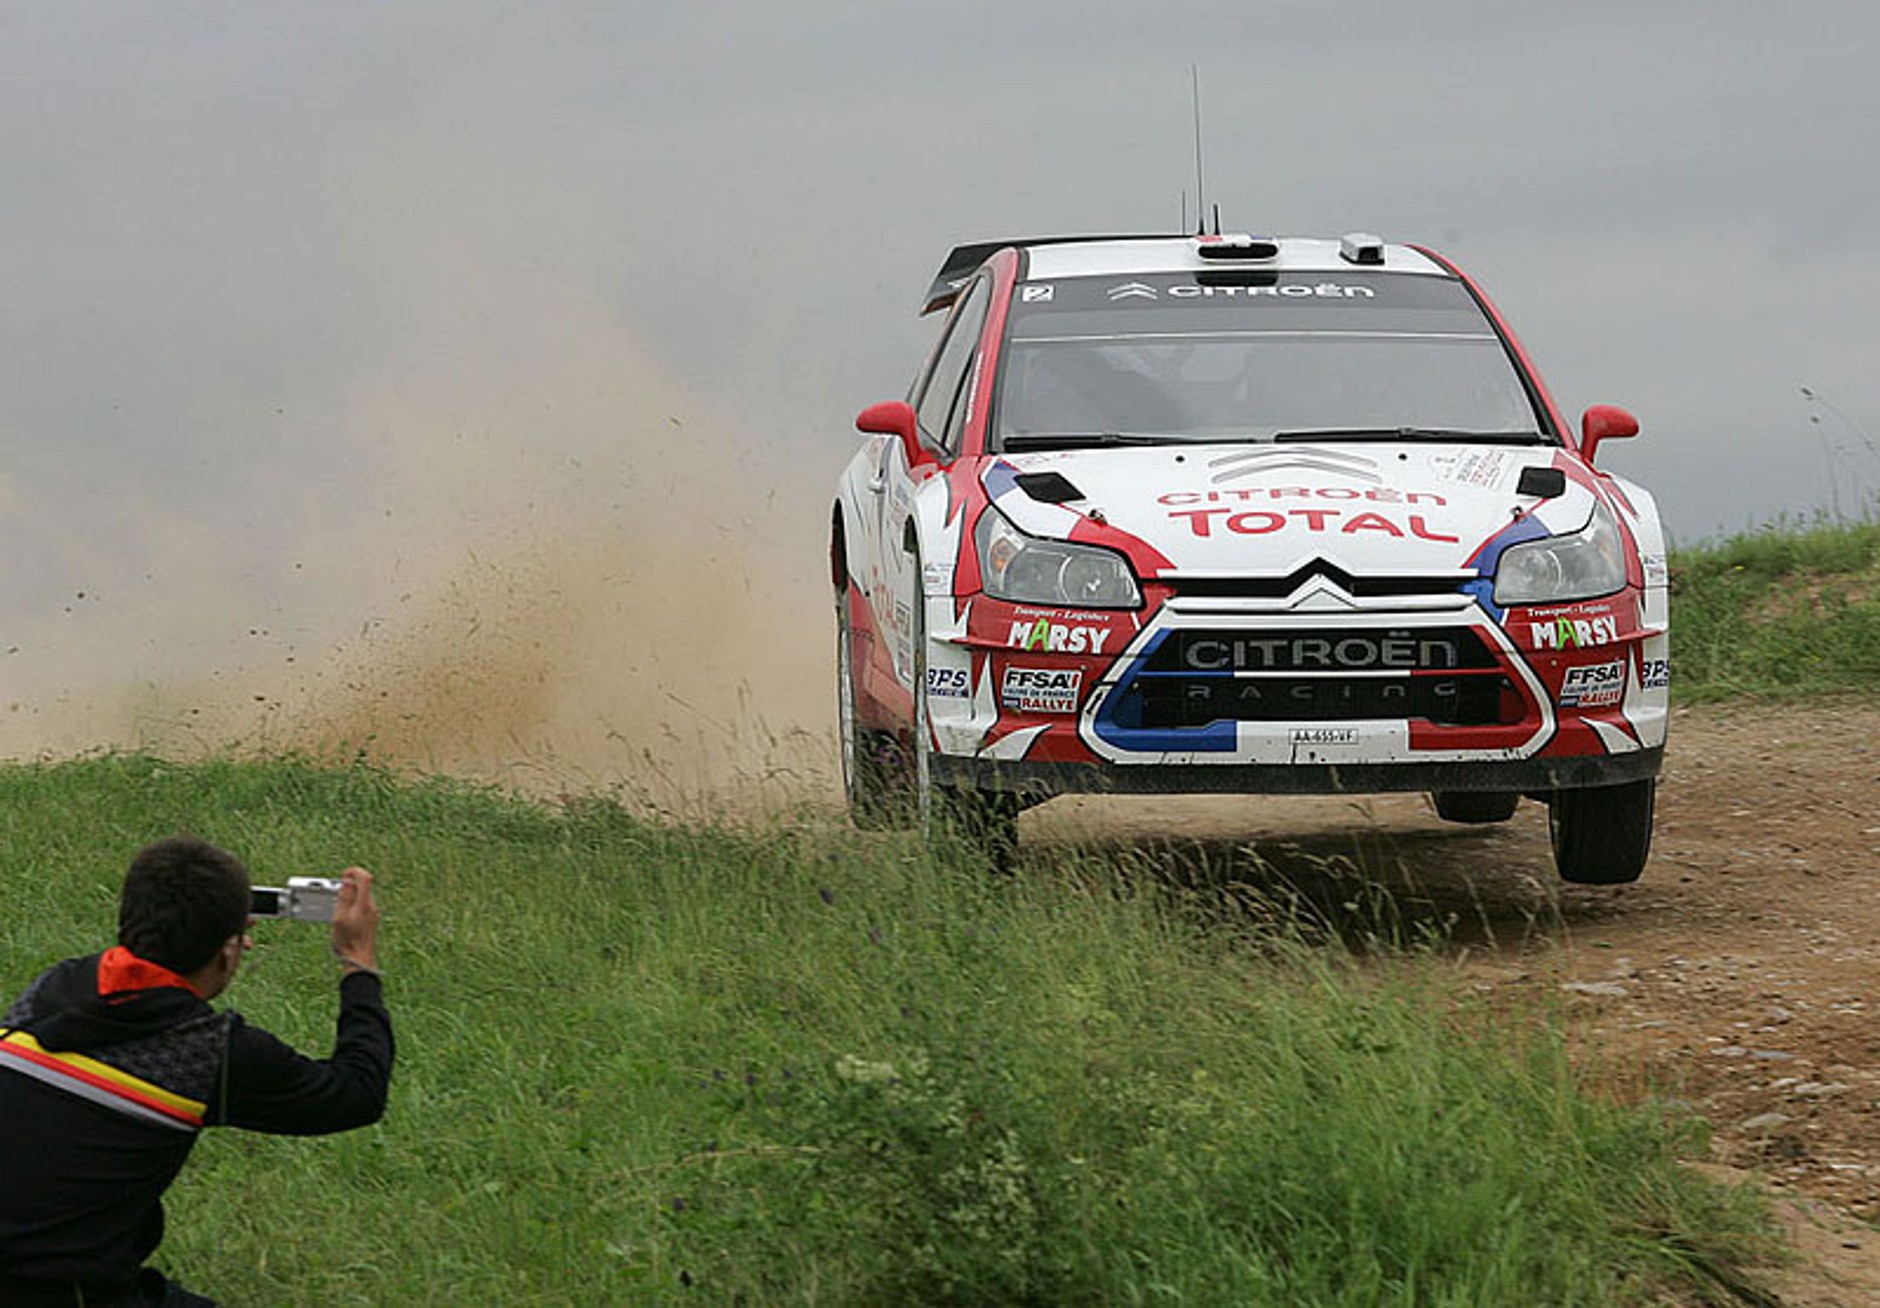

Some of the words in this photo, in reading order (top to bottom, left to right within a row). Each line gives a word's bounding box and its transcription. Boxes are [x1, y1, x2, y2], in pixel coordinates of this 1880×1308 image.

[1168, 508, 1459, 544] TOTAL
[1007, 618, 1111, 654] MARSY
[1531, 615, 1619, 650] MARSY
[1185, 631, 1459, 668] CITROËN
[1006, 671, 1071, 689] FFSA
[1567, 664, 1619, 684] FFSA
[1022, 698, 1073, 710] RALLYE
[1187, 683, 1457, 700] RACING
